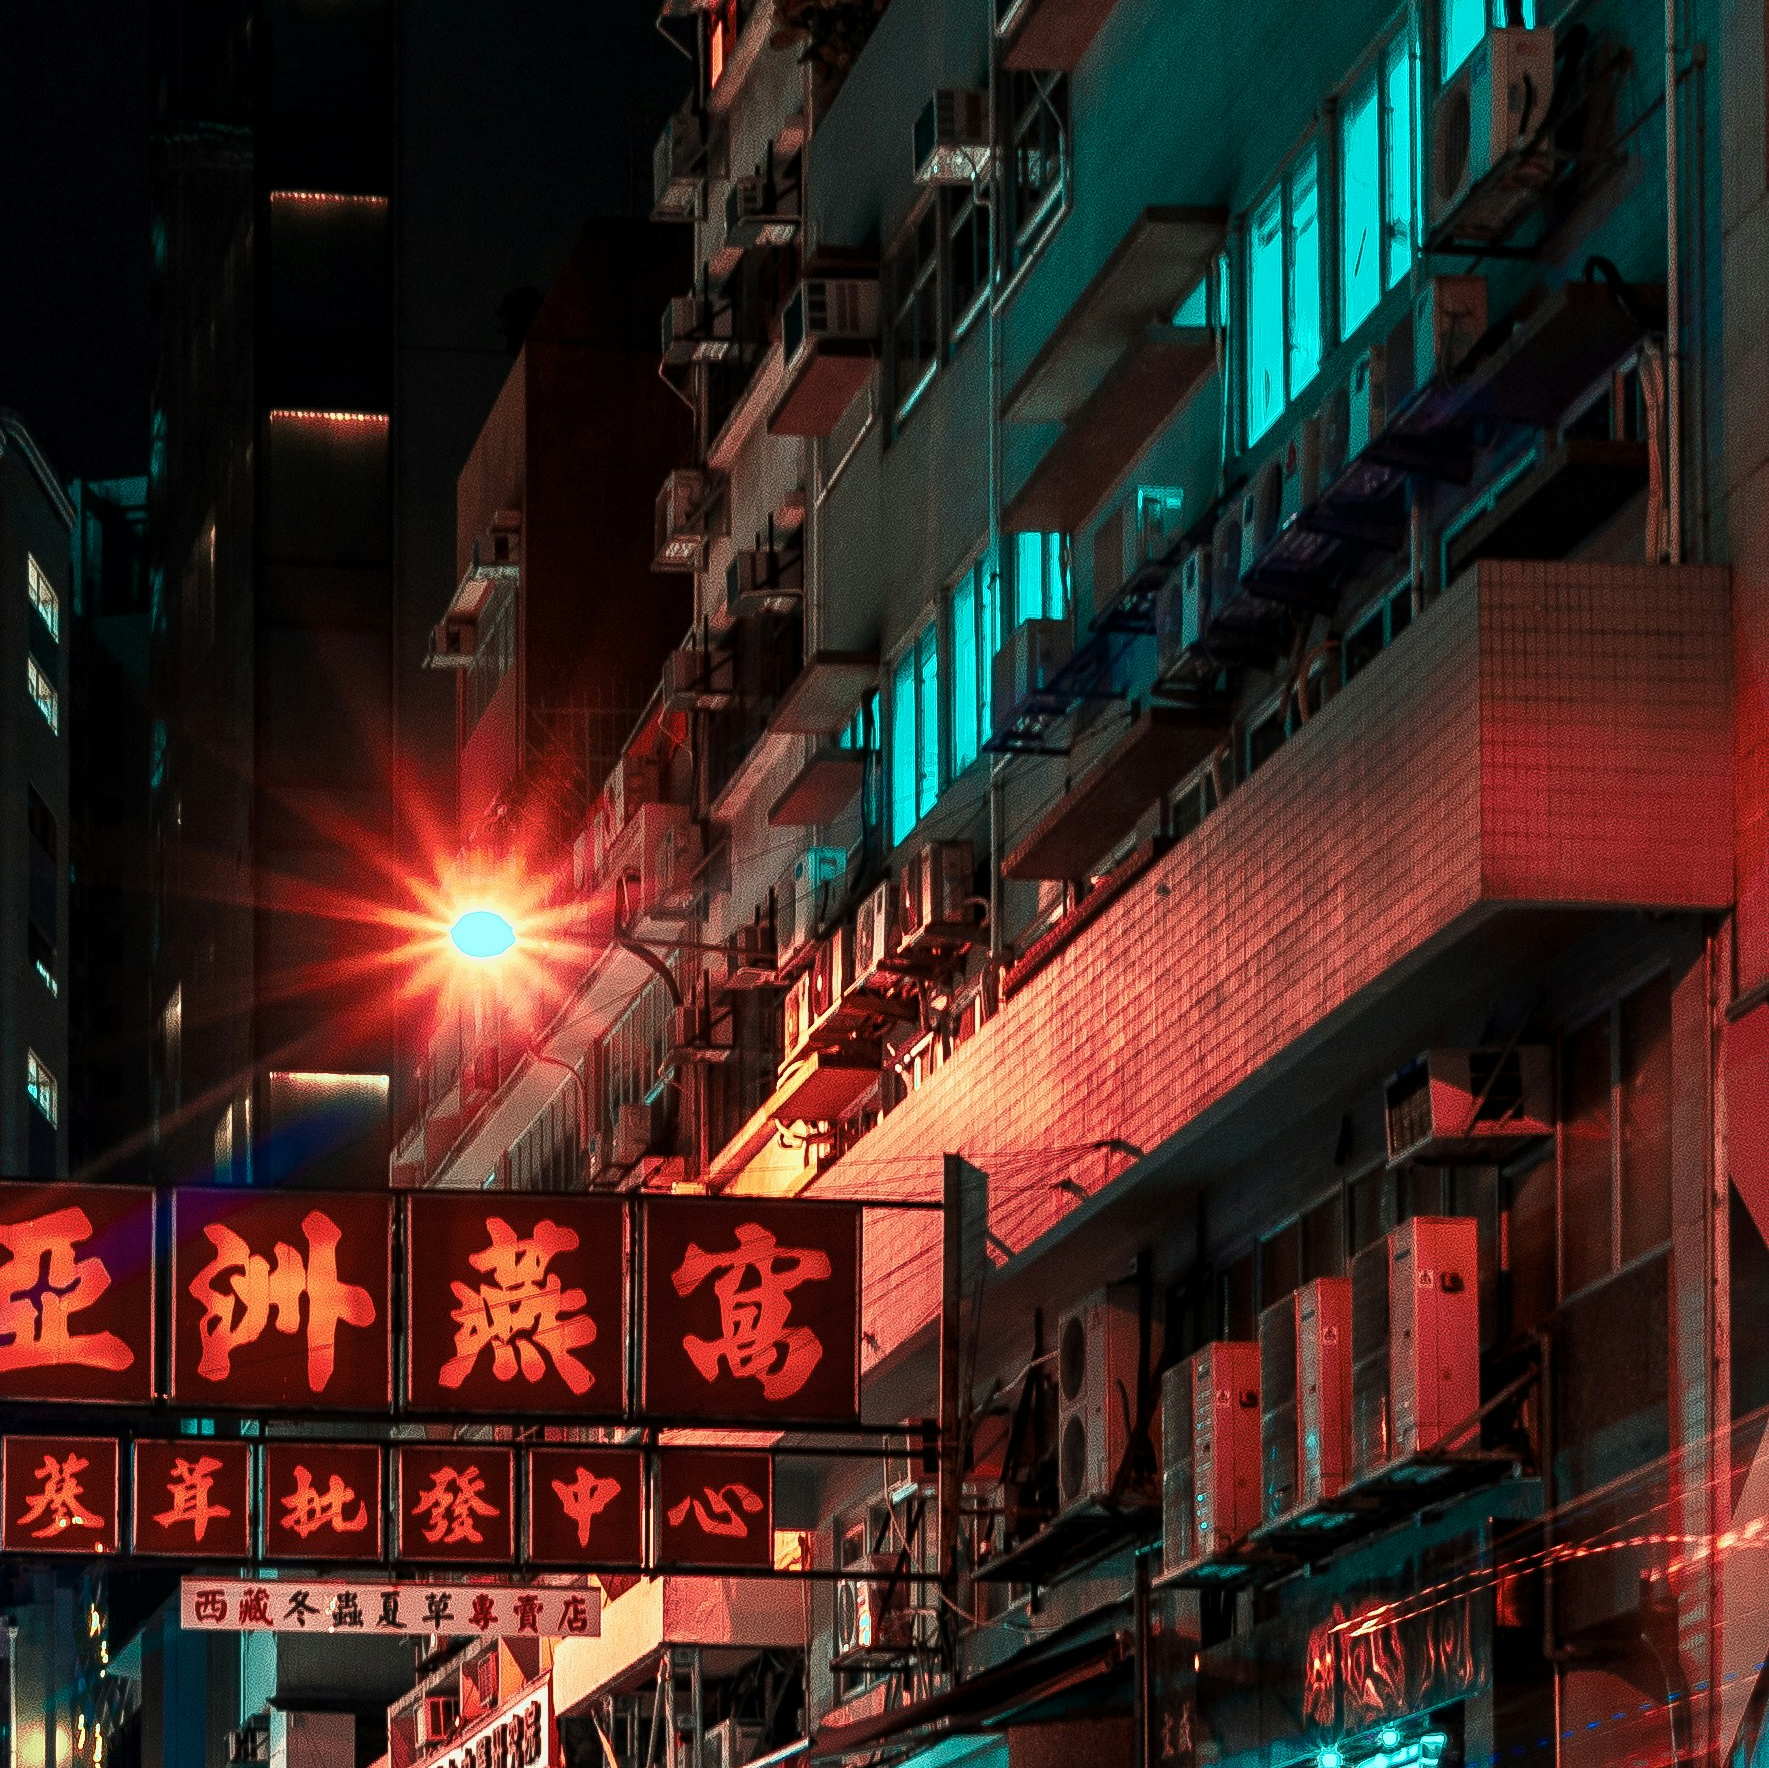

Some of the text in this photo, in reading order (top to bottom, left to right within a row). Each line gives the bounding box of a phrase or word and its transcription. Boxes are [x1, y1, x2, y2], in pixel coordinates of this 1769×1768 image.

[194, 1588, 589, 1634] 西藏冬蟲夏草專賣店
